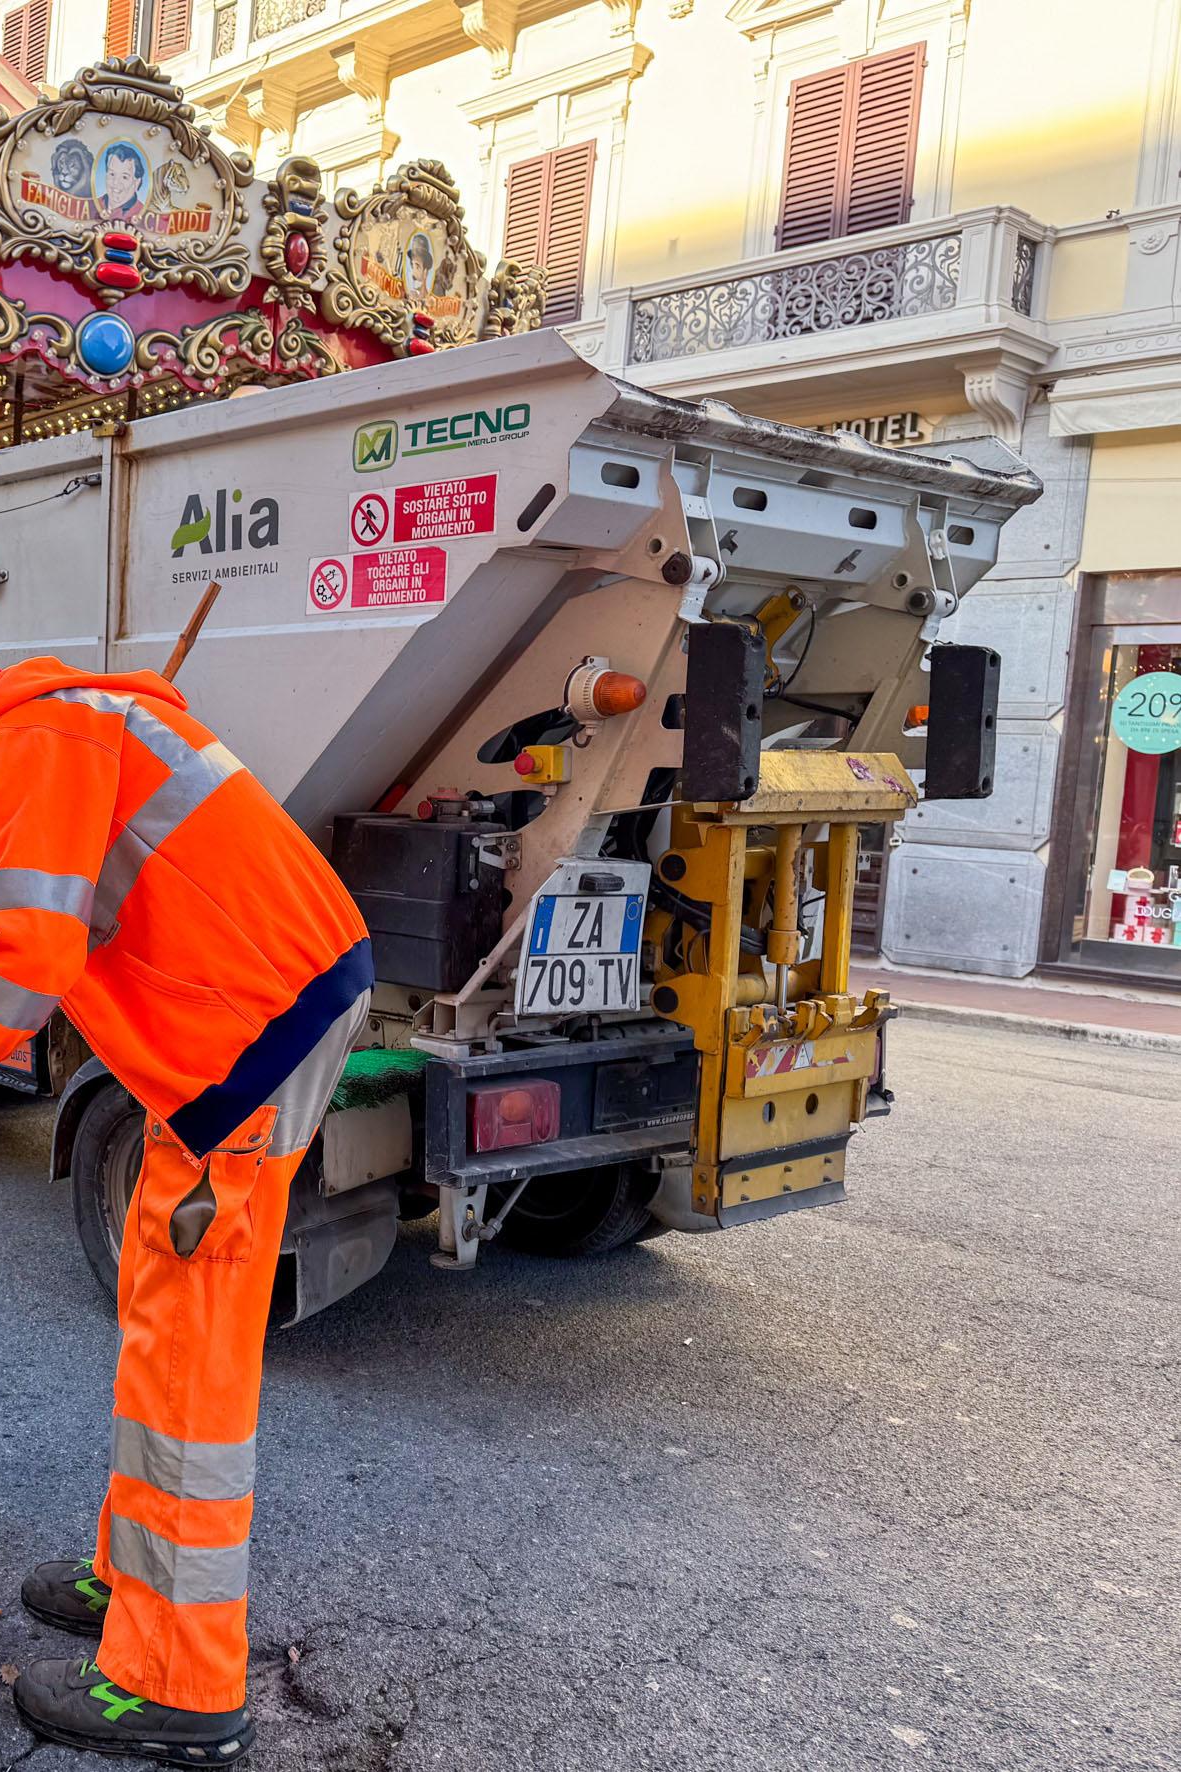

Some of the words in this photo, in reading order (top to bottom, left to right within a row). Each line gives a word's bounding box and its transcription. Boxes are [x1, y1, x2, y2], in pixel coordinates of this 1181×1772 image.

[26, 182, 91, 220] FAMIGLIA
[143, 211, 206, 235] CLAUDI
[404, 403, 531, 447] TECNO
[468, 436, 497, 448] MERLO
[498, 431, 530, 443] GROUP
[423, 480, 467, 498] VIETATO
[402, 496, 450, 515] SOSTARE
[452, 490, 487, 509] SOTTO
[170, 488, 280, 559] Alia
[416, 511, 457, 526] ORGANI
[459, 508, 471, 520] IN
[411, 520, 476, 540] MOVIMENTO
[378, 550, 417, 565] VIETATO
[171, 569, 212, 584] SERVIZI
[214, 561, 279, 579] AMBIENTALI
[367, 564, 410, 579] TOCCARE
[412, 562, 430, 576] GLI
[372, 577, 409, 593] ORGANI
[411, 576, 422, 588] IN
[368, 589, 427, 605] MOVIMENTO
[567, 901, 604, 949] ZA
[527, 958, 586, 1007] 709
[598, 958, 633, 1006] TV
